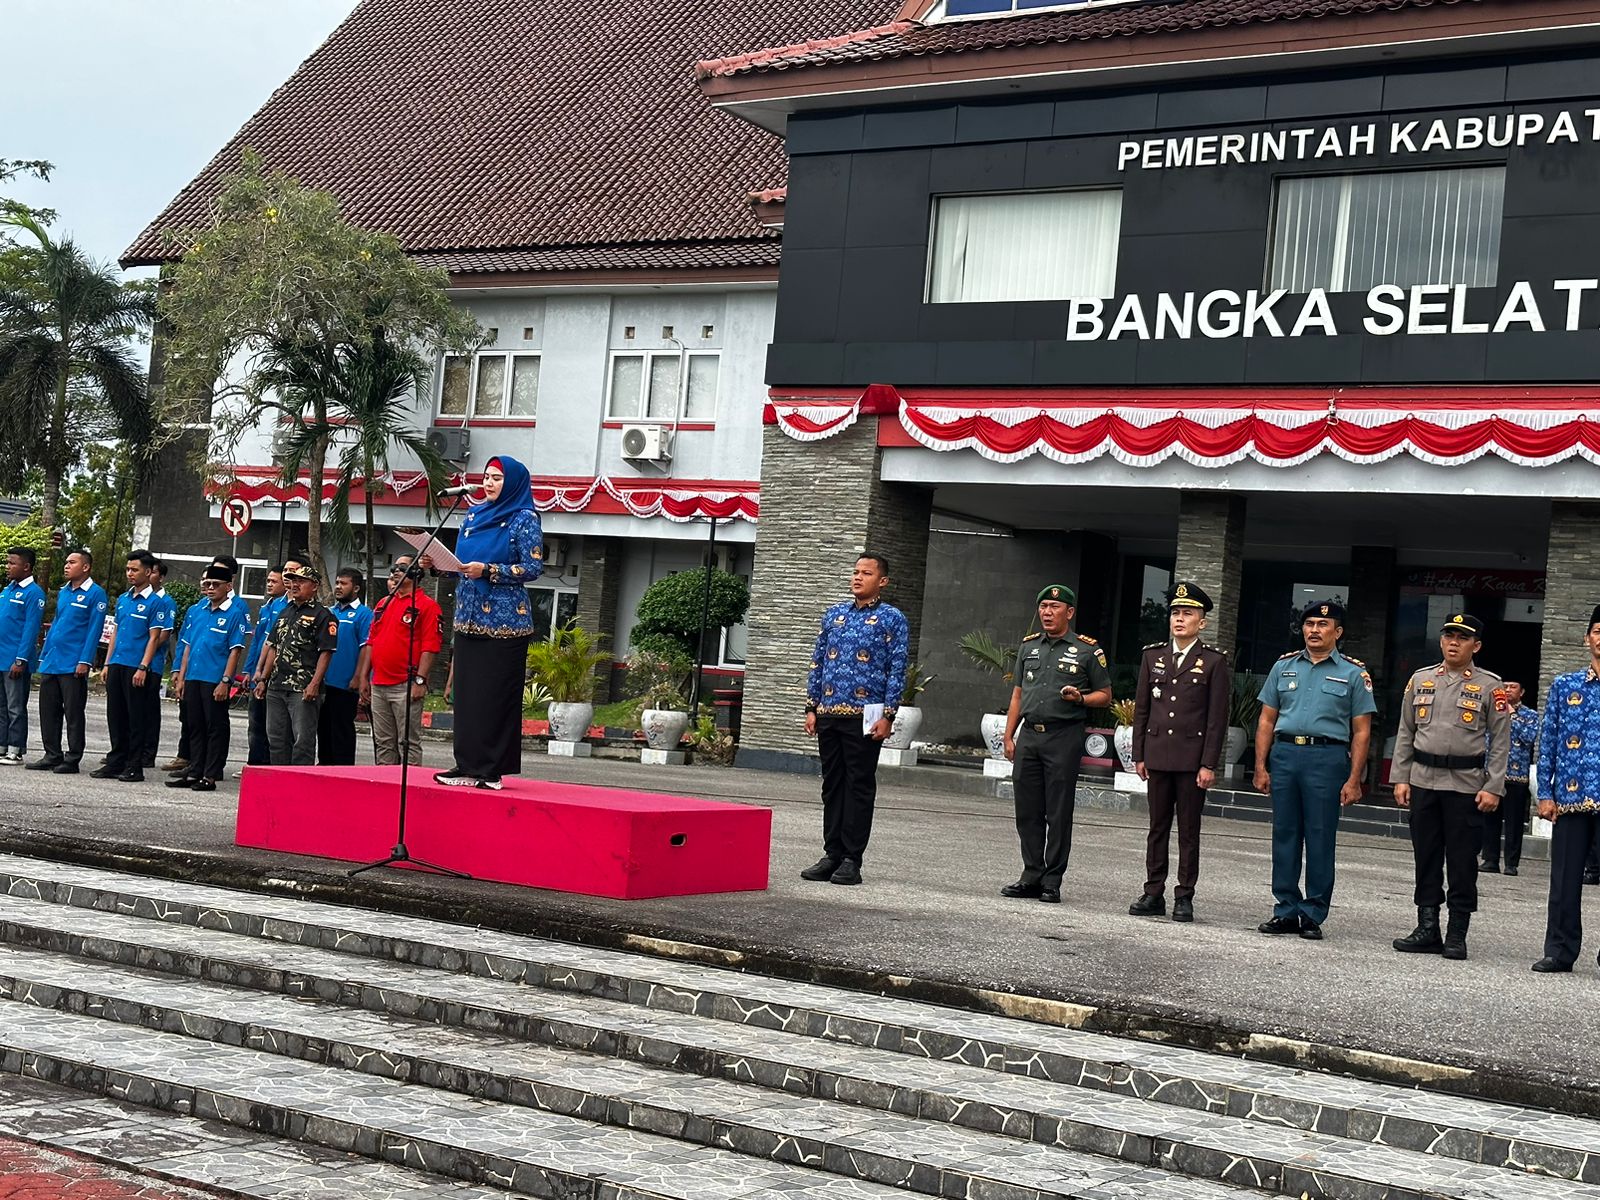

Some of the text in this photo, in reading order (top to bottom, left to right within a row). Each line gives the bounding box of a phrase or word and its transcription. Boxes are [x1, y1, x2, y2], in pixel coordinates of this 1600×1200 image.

[1117, 127, 1376, 171] PEMERINTAH
[1065, 278, 1600, 342] BANGKA SELAT
[1481, 575, 1528, 592] Kawa
[1460, 691, 1482, 701] POLRI
